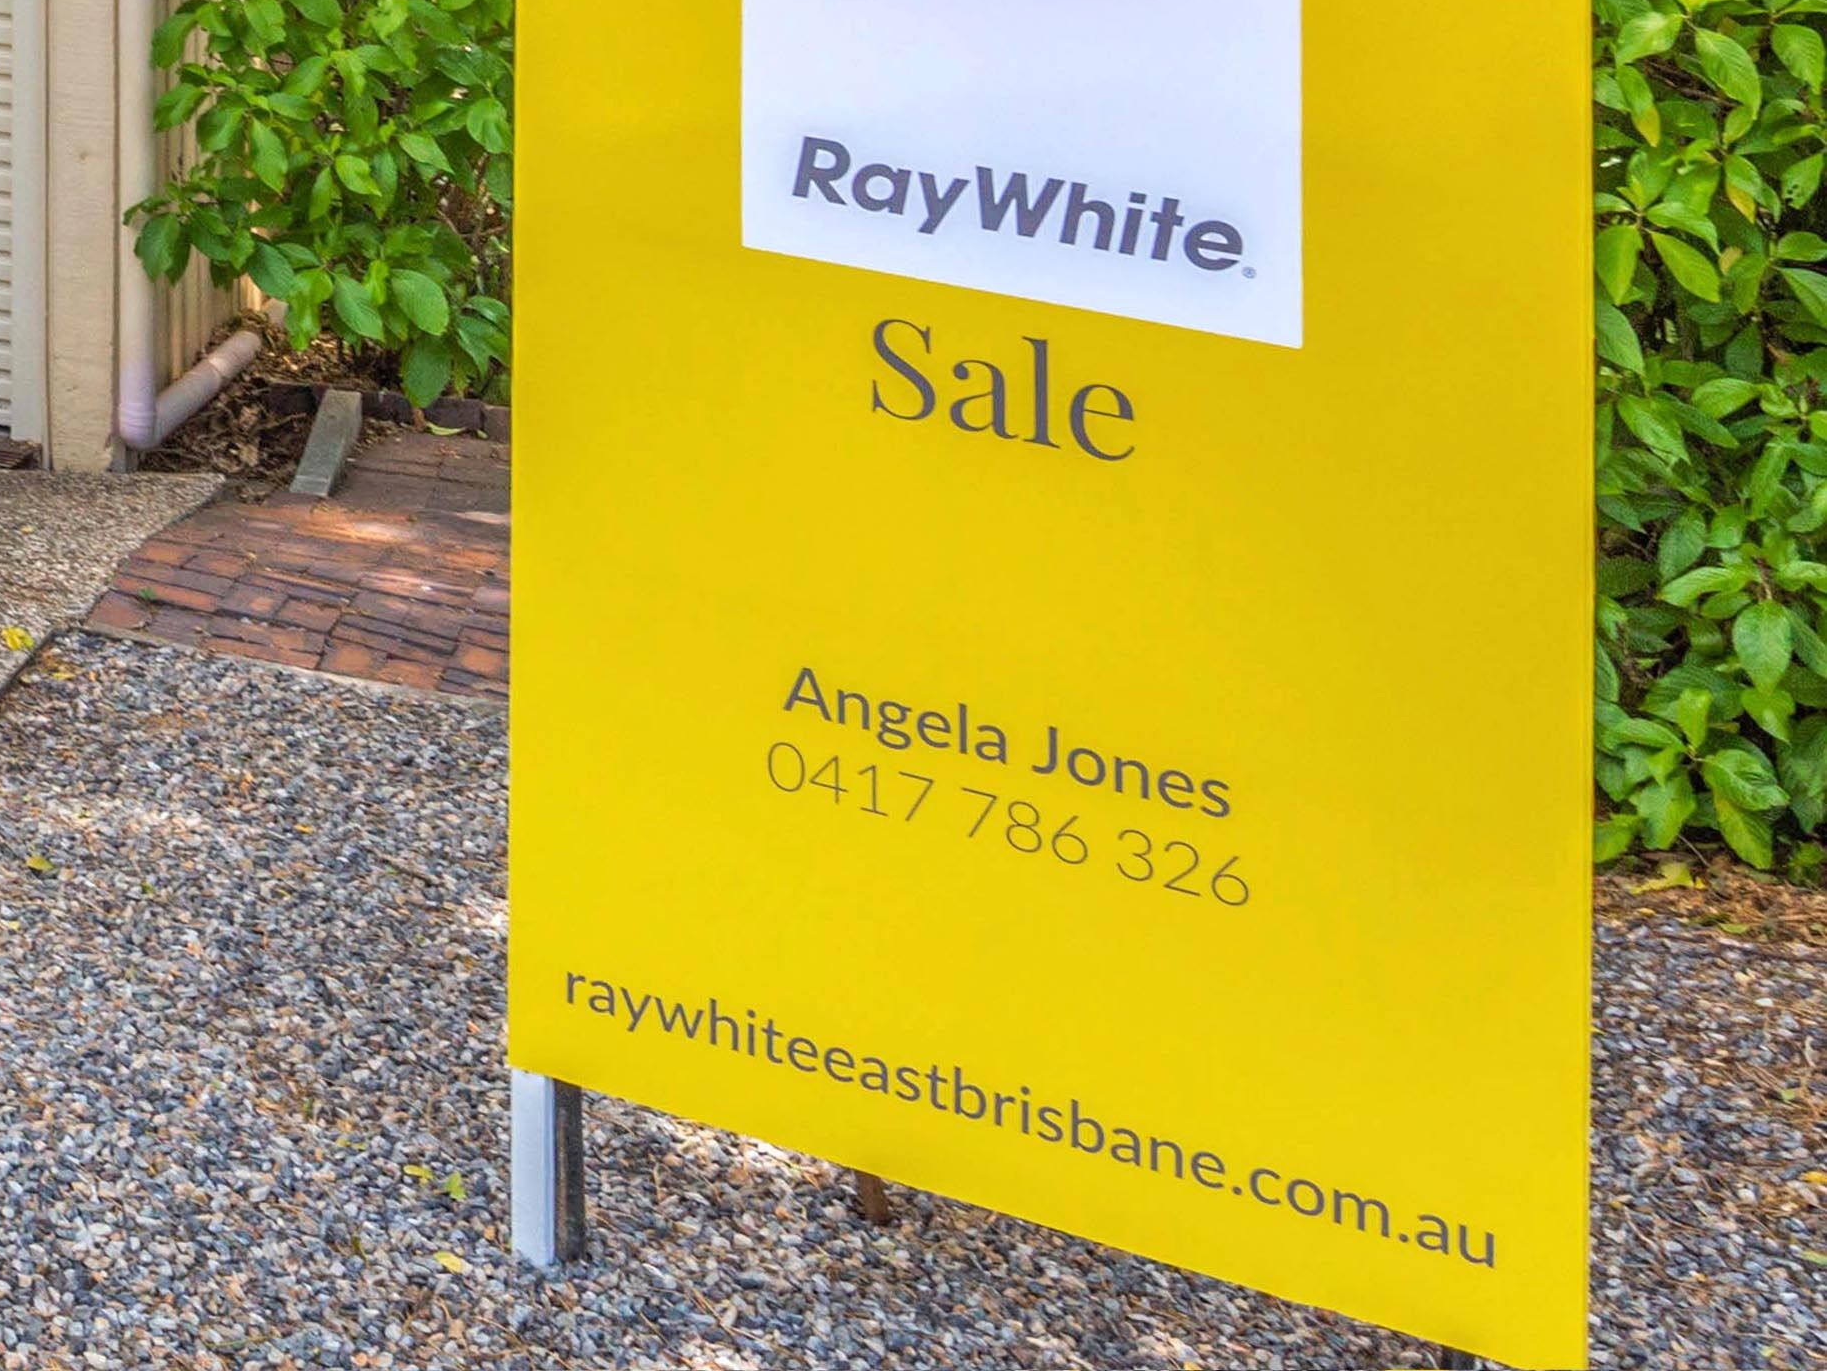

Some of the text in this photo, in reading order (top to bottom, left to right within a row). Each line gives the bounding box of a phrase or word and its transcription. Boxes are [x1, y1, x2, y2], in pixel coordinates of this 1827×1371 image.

[871, 318, 1136, 462] Sale
[782, 666, 1232, 819] Angela Jones
[766, 740, 1251, 908] 0417 786 326
[565, 970, 1496, 1270] raywhiteeastbrisbane.com.au
